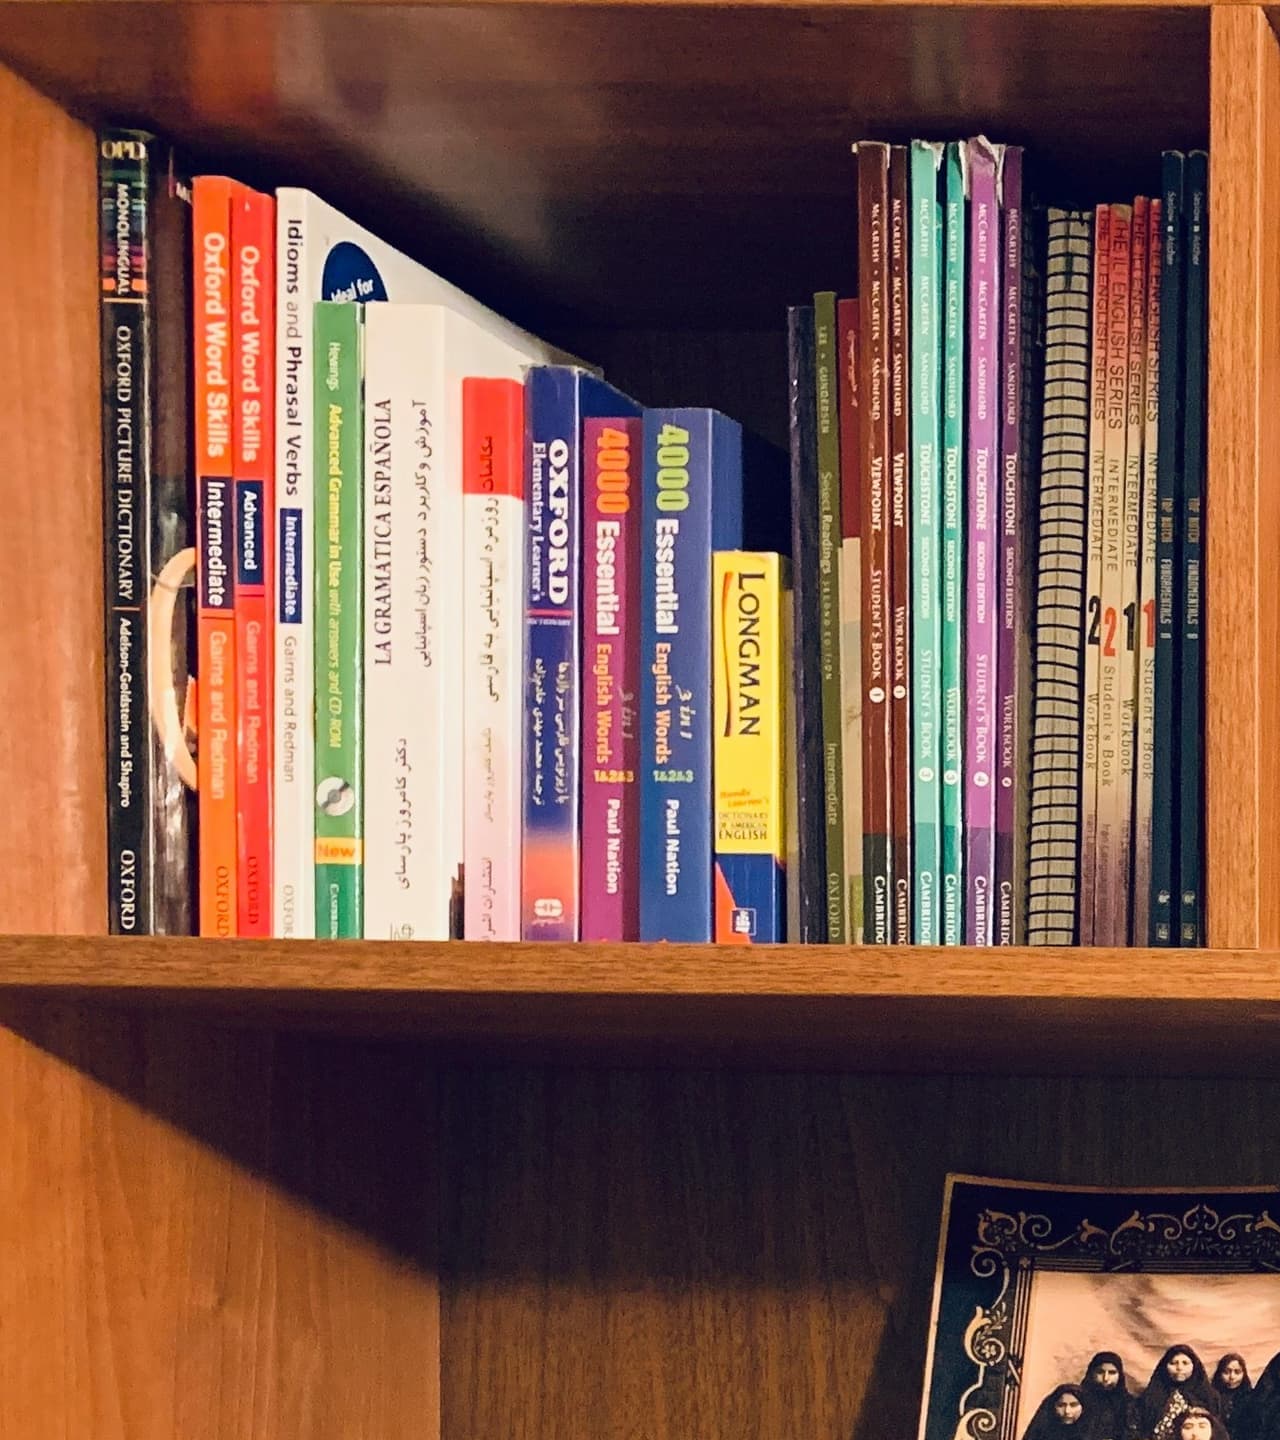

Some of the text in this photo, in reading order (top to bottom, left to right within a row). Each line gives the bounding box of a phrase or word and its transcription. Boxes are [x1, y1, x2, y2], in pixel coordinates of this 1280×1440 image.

[102, 140, 146, 160] OPD
[116, 183, 132, 295] MONOLINGUAL
[1110, 219, 1129, 253] THE
[203, 232, 226, 457] Oxford Word Skills
[240, 245, 261, 462] Oxford Word Skills
[286, 218, 303, 496] Idioms and Phrasal Verbs
[1109, 282, 1128, 358] ENGLISH
[412, 399, 432, 459] آموزش
[1108, 364, 1126, 429] SERIES
[116, 325, 135, 601] OXFORD PICTURE DICTIONARY
[412, 472, 431, 521] کاربرد
[870, 456, 883, 532] VIEWPOINT
[892, 452, 905, 527] VIEWPOINT
[919, 443, 932, 526] TOUCHSTONE
[946, 446, 959, 529] TOUCHSTONE
[206, 481, 225, 607] Intermediate
[243, 490, 257, 570] Advanced
[370, 398, 391, 665] LA GRAMÁTICA ESPAÑOLA
[413, 528, 431, 573] دستور
[529, 441, 546, 601] Elementary Learner's
[548, 438, 569, 605] OXFORD
[821, 472, 834, 574] Select Readings
[975, 447, 988, 624] TOUCHSTONE SECOND EDITION
[1106, 458, 1120, 572] INTERMEDIATE
[284, 516, 298, 617] Intermediate
[328, 404, 343, 748] Advanced Grammar in Use with answers and CD-ROM
[413, 576, 431, 606] زبان
[592, 428, 630, 764] 4000 Essential English Words
[652, 424, 690, 764] 4000 Essential English Words
[413, 608, 433, 668] اسپانیایی
[737, 571, 766, 736] LONGMAN
[871, 569, 883, 680] STUDENT'S BOOK
[894, 605, 907, 681] WORKBOOK
[1103, 607, 1117, 657] 2
[118, 617, 133, 808] Adelson-Goldstein and Shapiro
[945, 687, 959, 762] WORKBOOK
[974, 654, 988, 763] STUDENT'S BOOK
[1102, 665, 1116, 787] Student's Book
[1121, 698, 1134, 776] Workbook
[826, 742, 839, 825] Intermediate
[666, 799, 680, 895] Paul Nation
[719, 830, 768, 841] ENGLISH
[121, 849, 136, 930] OXFORD
[828, 872, 841, 938] OXFORD
